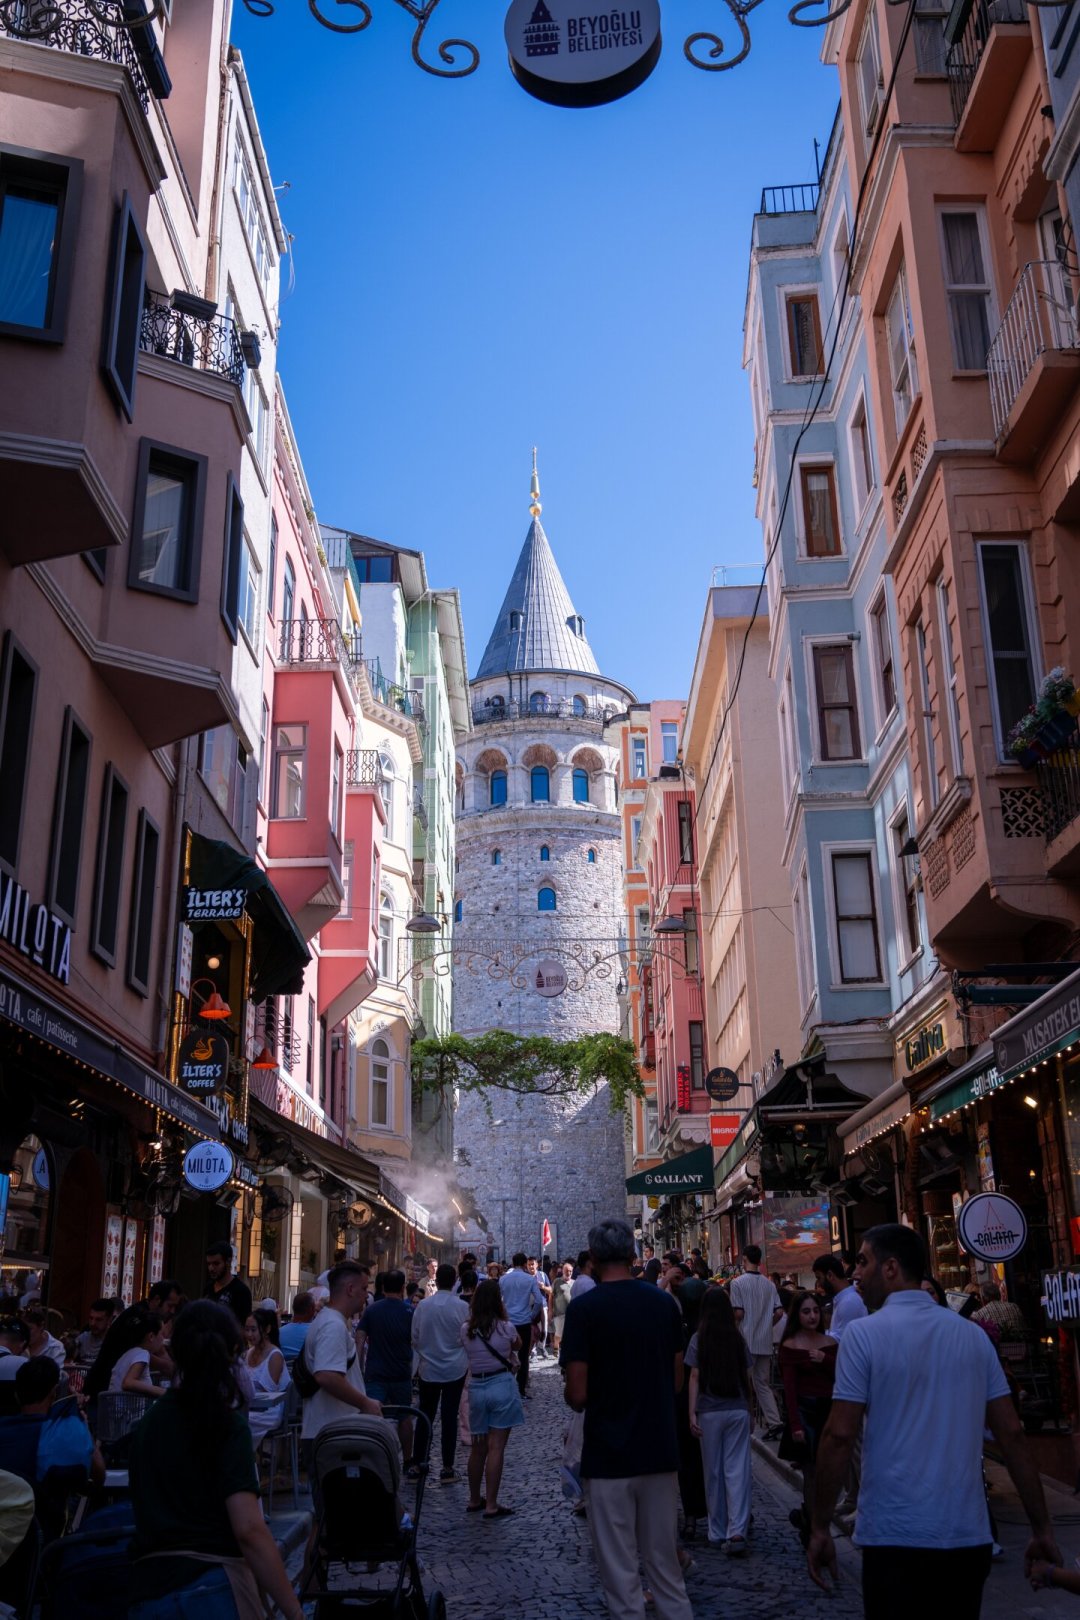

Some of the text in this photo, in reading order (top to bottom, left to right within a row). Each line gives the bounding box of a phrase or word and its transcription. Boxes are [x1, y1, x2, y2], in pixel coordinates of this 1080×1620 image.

[567, 9, 641, 37] BEYOĞLU
[568, 29, 643, 53] BELEDİYESİ
[186, 887, 245, 908] İLTER'S
[187, 907, 241, 919] TERRACE
[27, 1008, 42, 1027] cafe
[46, 1020, 78, 1048] patisserie
[1022, 1003, 1070, 1055] MUSATEK
[181, 1061, 222, 1078] İLTER'S
[186, 1079, 216, 1089] COFFEE
[654, 1174, 703, 1184] GALLANT
[974, 1230, 1020, 1247] GALATA
